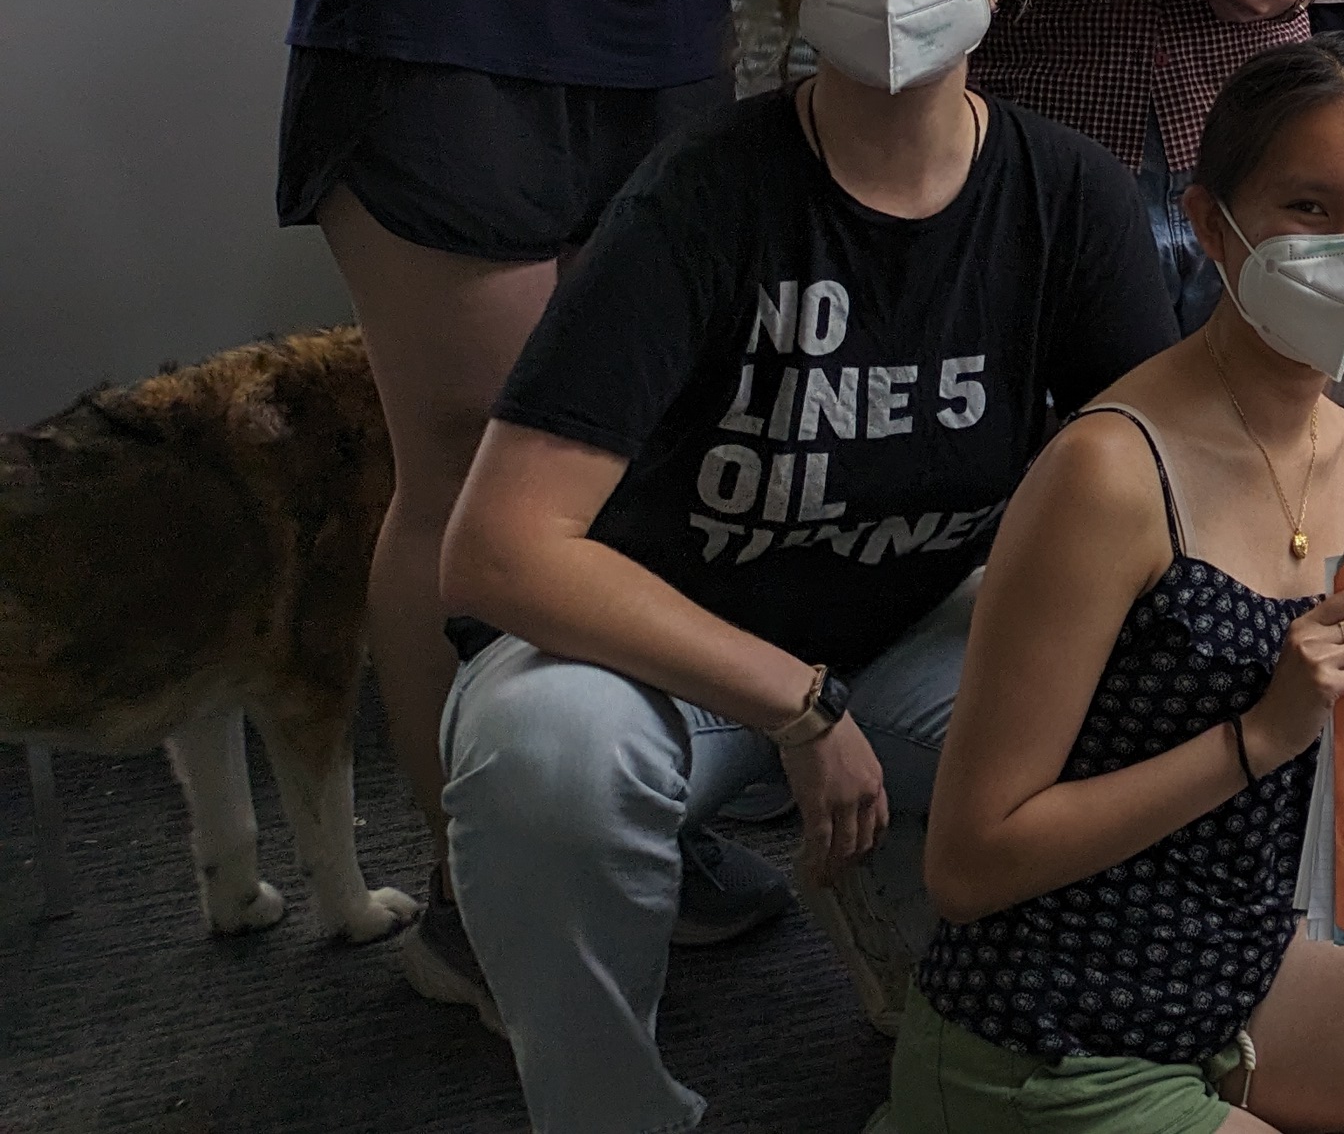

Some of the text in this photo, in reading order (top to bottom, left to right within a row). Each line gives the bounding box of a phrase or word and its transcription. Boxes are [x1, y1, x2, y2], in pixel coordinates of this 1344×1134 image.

[746, 278, 850, 358] NO
[717, 354, 987, 442] LINE 5
[695, 442, 848, 524] OIL
[688, 500, 1006, 566] TUNNE
